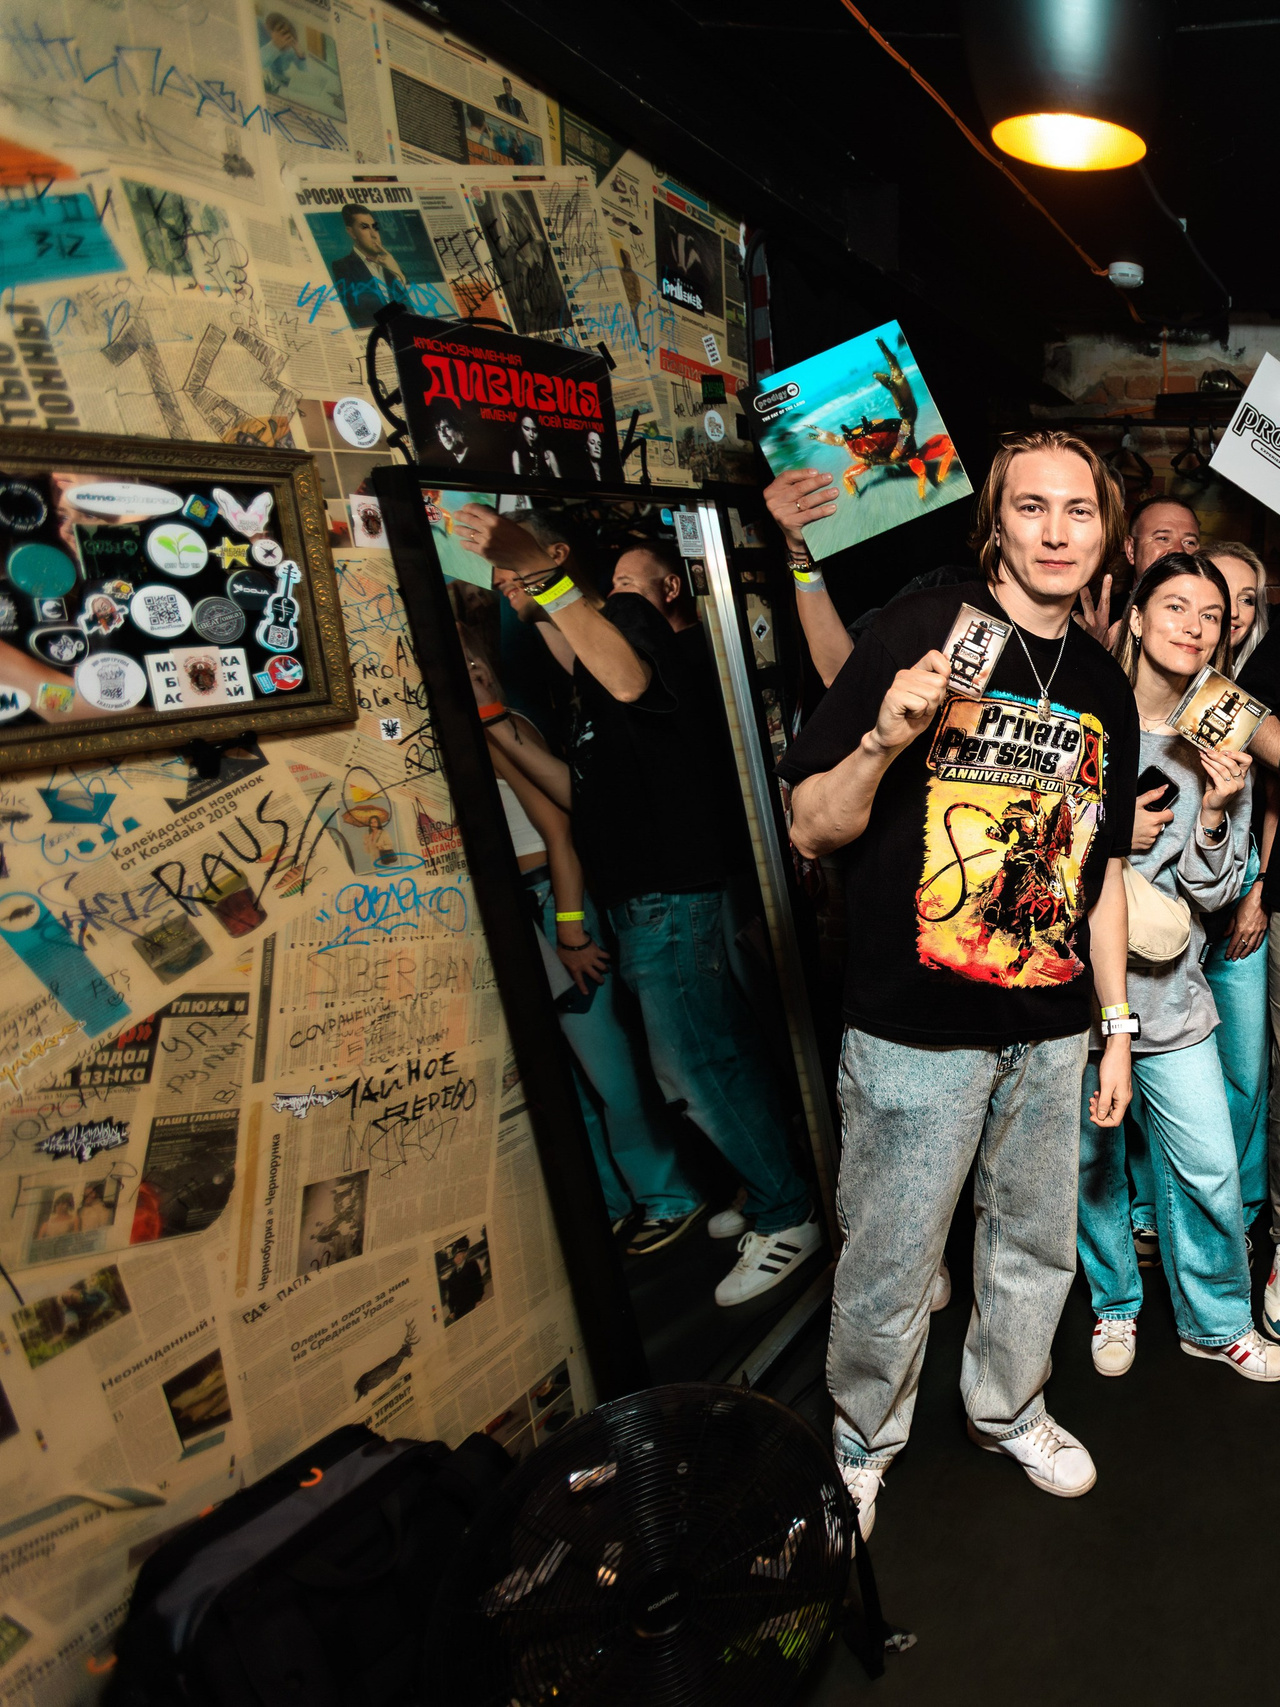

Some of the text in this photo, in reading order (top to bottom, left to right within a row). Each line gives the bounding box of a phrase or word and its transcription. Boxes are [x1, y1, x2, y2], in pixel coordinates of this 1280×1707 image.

[350, 187, 383, 204] ЧЕРЕЗ
[384, 186, 414, 203] ЯЛТУ
[421, 354, 603, 419] ДИВИЗИЯ
[975, 704, 1080, 752] Private
[111, 775, 265, 861] Калейдоскоп новинок
[120, 800, 238, 872] от Kosadaka 2019
[421, 838, 463, 858] ЦЫГАНОВ
[424, 851, 457, 868] ПЛАТИЛ
[440, 864, 455, 875] 700
[155, 1110, 239, 1127] НАШЕ ГЛАВНОЕ
[264, 1133, 281, 1207] Чернорунка
[257, 1218, 274, 1291] Чернобурка
[276, 1274, 312, 1302] ПАПА
[290, 1329, 329, 1353] Олень
[340, 1299, 374, 1322] охота
[374, 1290, 386, 1301] за
[387, 1276, 411, 1295] ним
[101, 1319, 209, 1392] Неожиданный
[293, 1296, 396, 1362] на Среднем Урале
